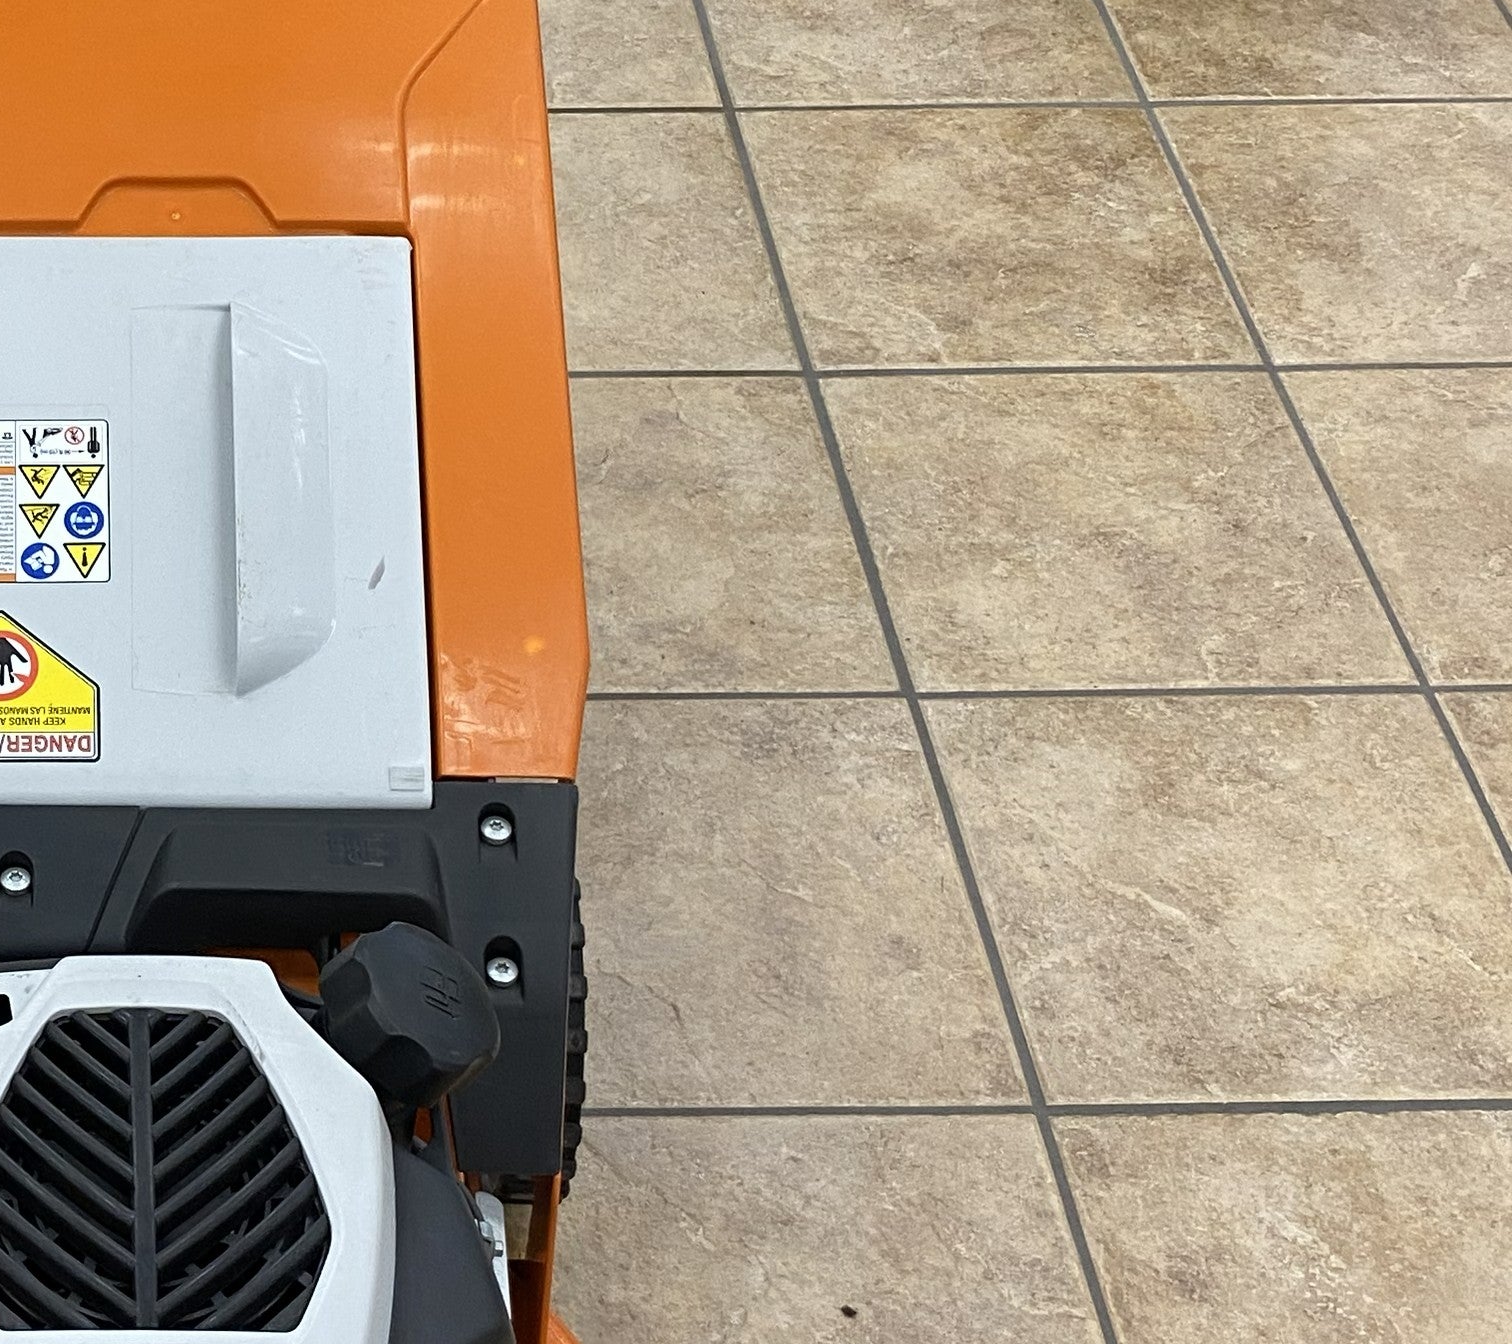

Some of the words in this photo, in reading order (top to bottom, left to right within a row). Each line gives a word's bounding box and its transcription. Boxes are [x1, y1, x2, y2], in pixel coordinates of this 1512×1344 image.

[30, 706, 45, 715] LAS
[9, 717, 40, 726] HANDS
[42, 717, 66, 726] KEEP
